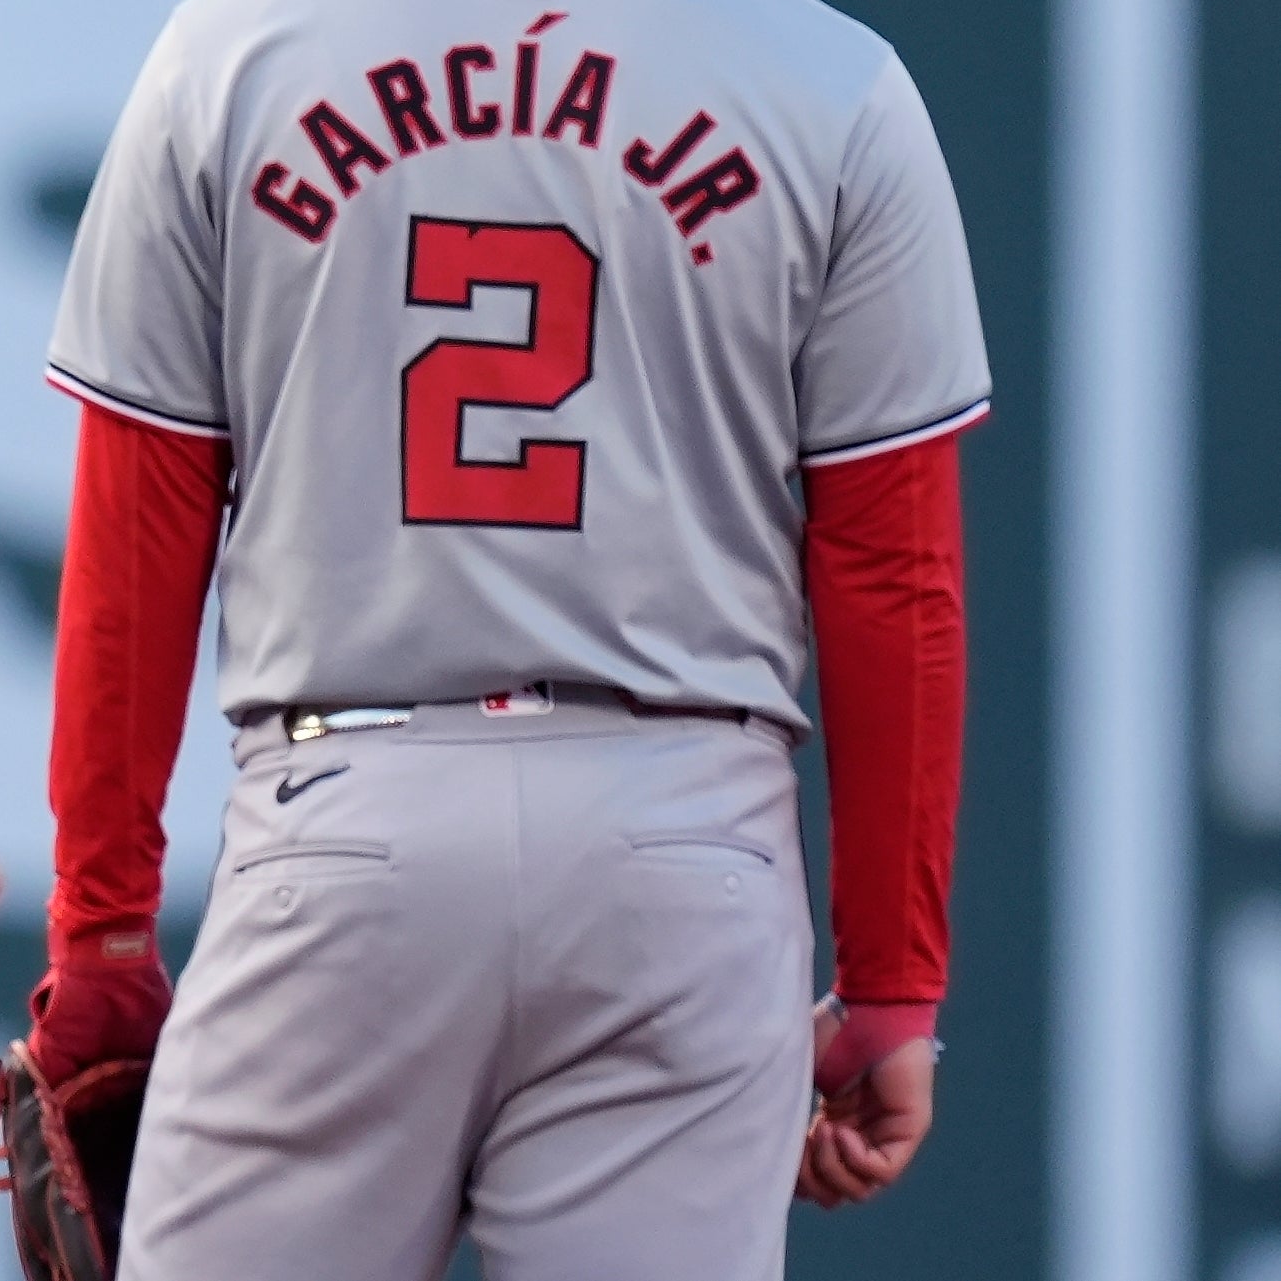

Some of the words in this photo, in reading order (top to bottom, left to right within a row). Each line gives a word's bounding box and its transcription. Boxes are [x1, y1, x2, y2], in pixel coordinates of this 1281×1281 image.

[251, 11, 618, 244] GARCÍA
[622, 109, 763, 266] JR.
[400, 214, 600, 532] 2
